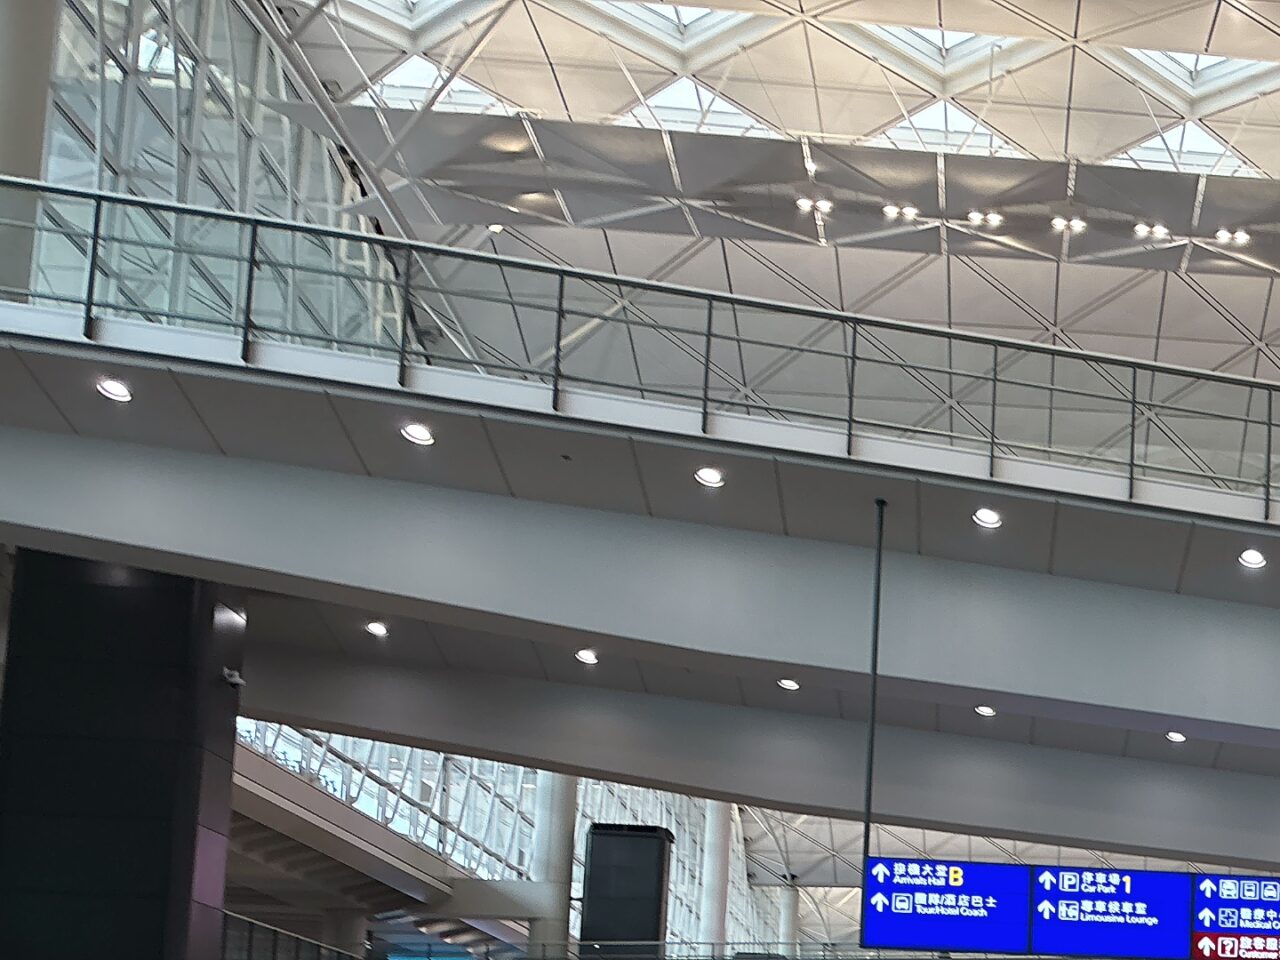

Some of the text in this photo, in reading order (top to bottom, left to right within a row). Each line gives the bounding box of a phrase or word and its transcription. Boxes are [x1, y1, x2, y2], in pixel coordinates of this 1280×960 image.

[892, 876, 946, 886] Arrivals Hall
[949, 866, 964, 886] B
[1081, 884, 1116, 894] Car Park
[1122, 875, 1131, 894] 1
[960, 908, 988, 917] Coach
[1080, 913, 1159, 926] Limousine Lounge
[1239, 919, 1272, 929] Medical
[1239, 950, 1278, 960] Customer
